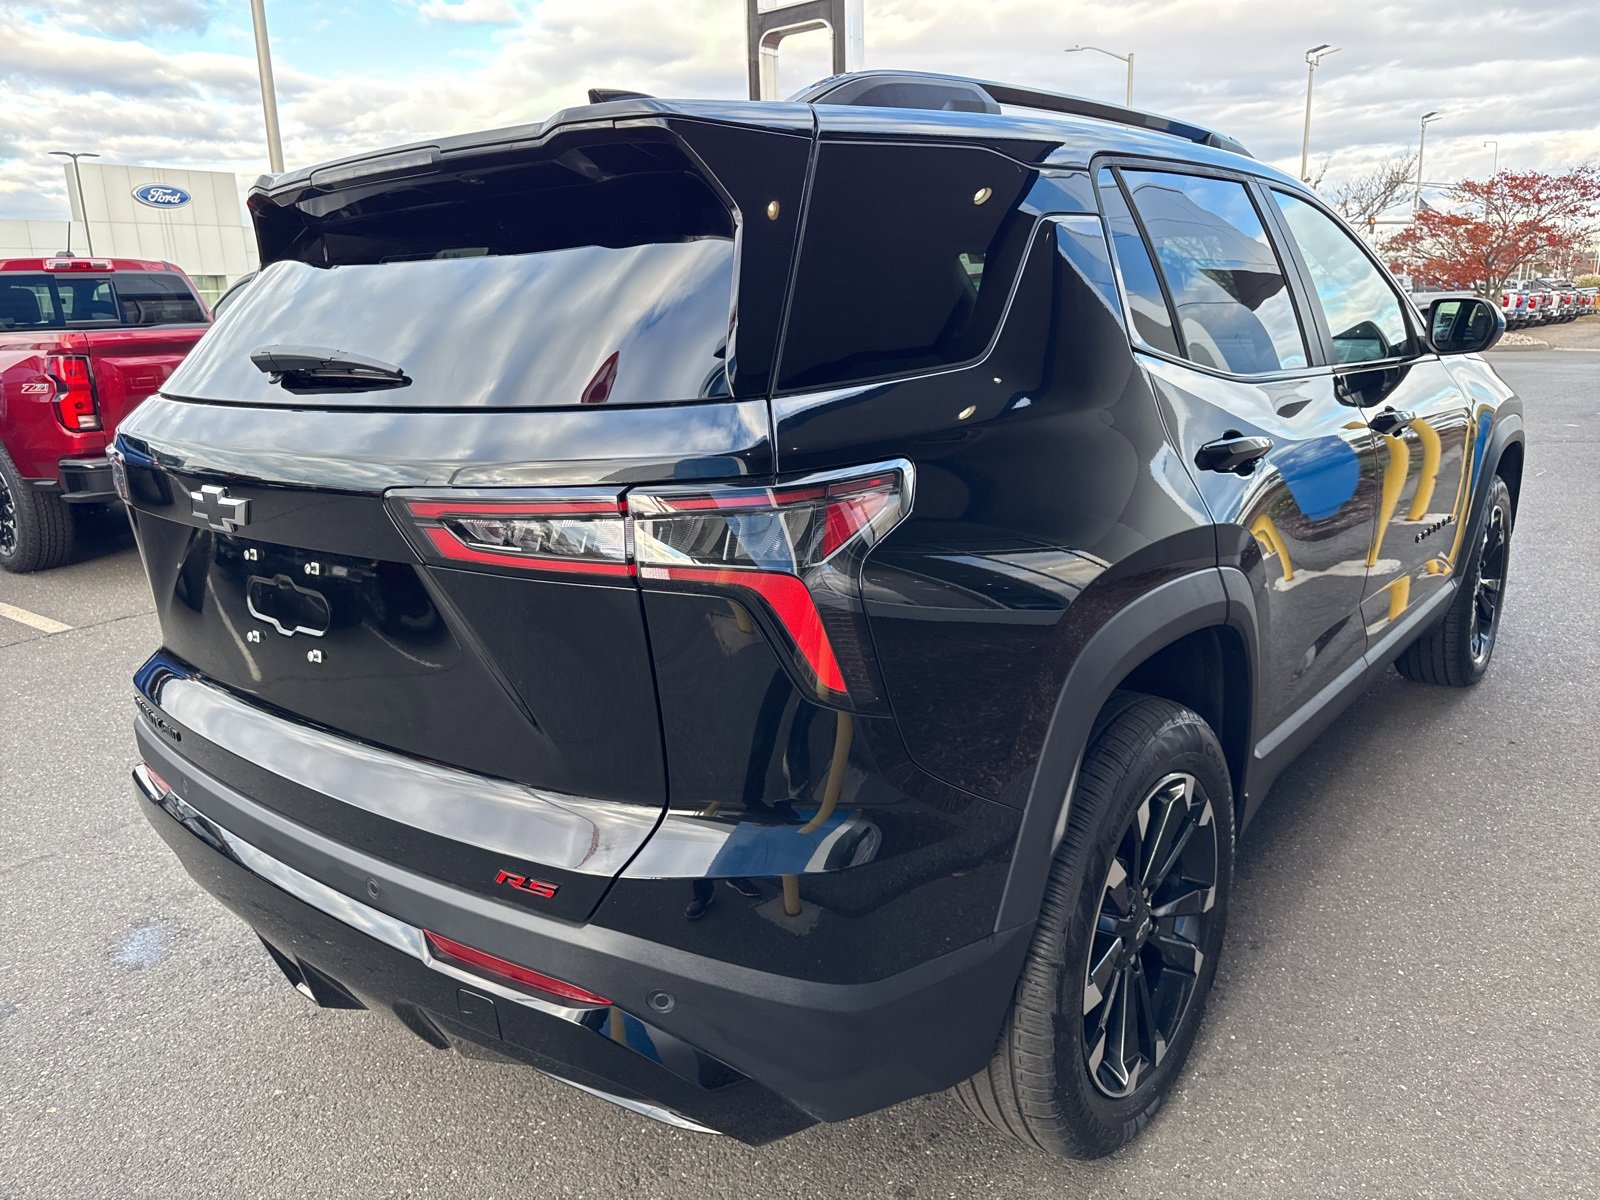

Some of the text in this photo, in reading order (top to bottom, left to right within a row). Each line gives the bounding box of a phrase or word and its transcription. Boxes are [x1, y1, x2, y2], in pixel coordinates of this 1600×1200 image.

[147, 188, 181, 204] Ford
[21, 383, 49, 394] Z71
[496, 869, 559, 898] RS
